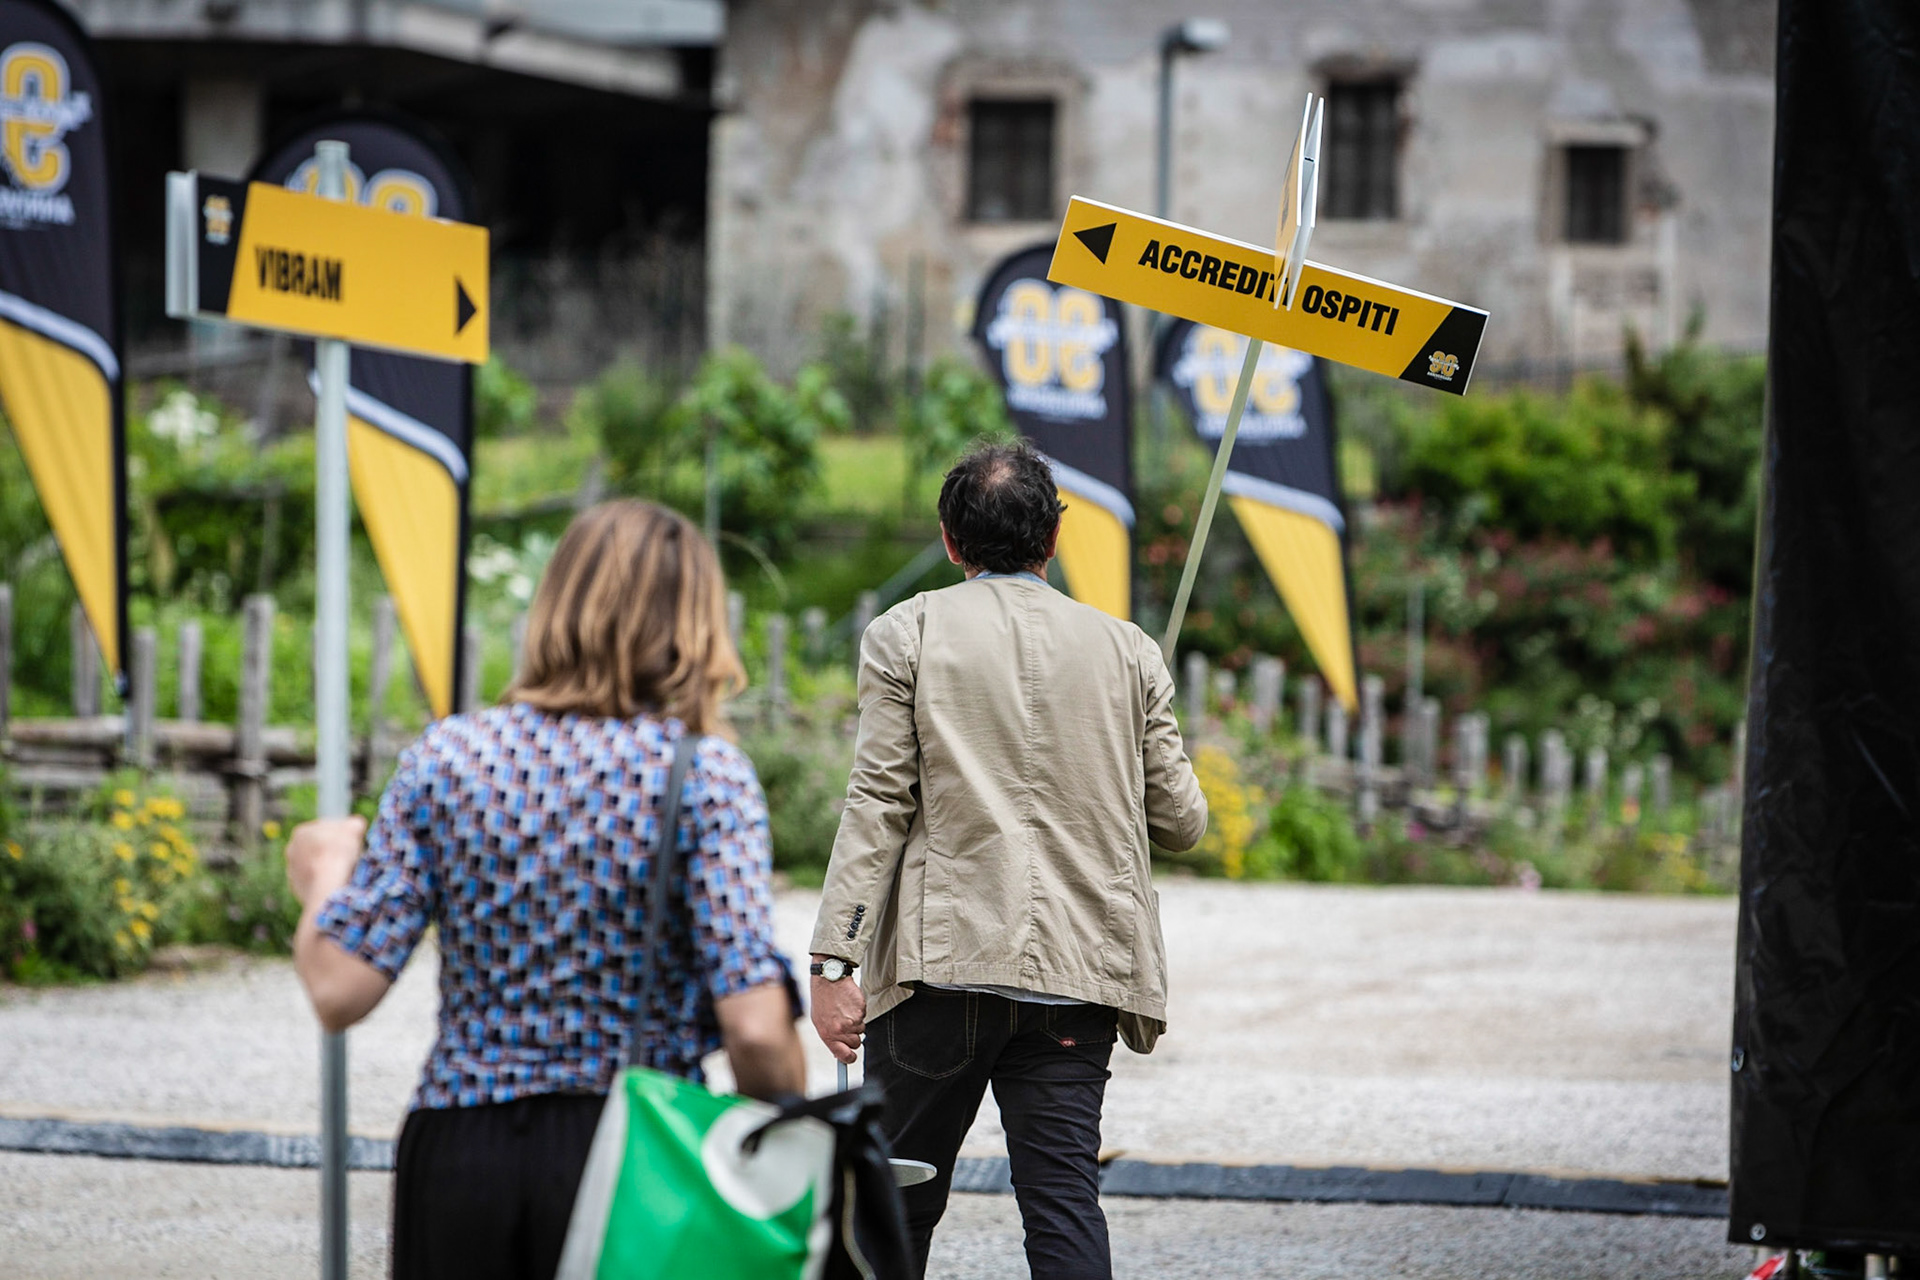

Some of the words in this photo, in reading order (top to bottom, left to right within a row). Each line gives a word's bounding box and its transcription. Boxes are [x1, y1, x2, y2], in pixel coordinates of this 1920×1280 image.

[255, 245, 342, 302] VIBRAM
[1138, 239, 1289, 307] ACCREDI
[1302, 285, 1400, 336] OSPITI
